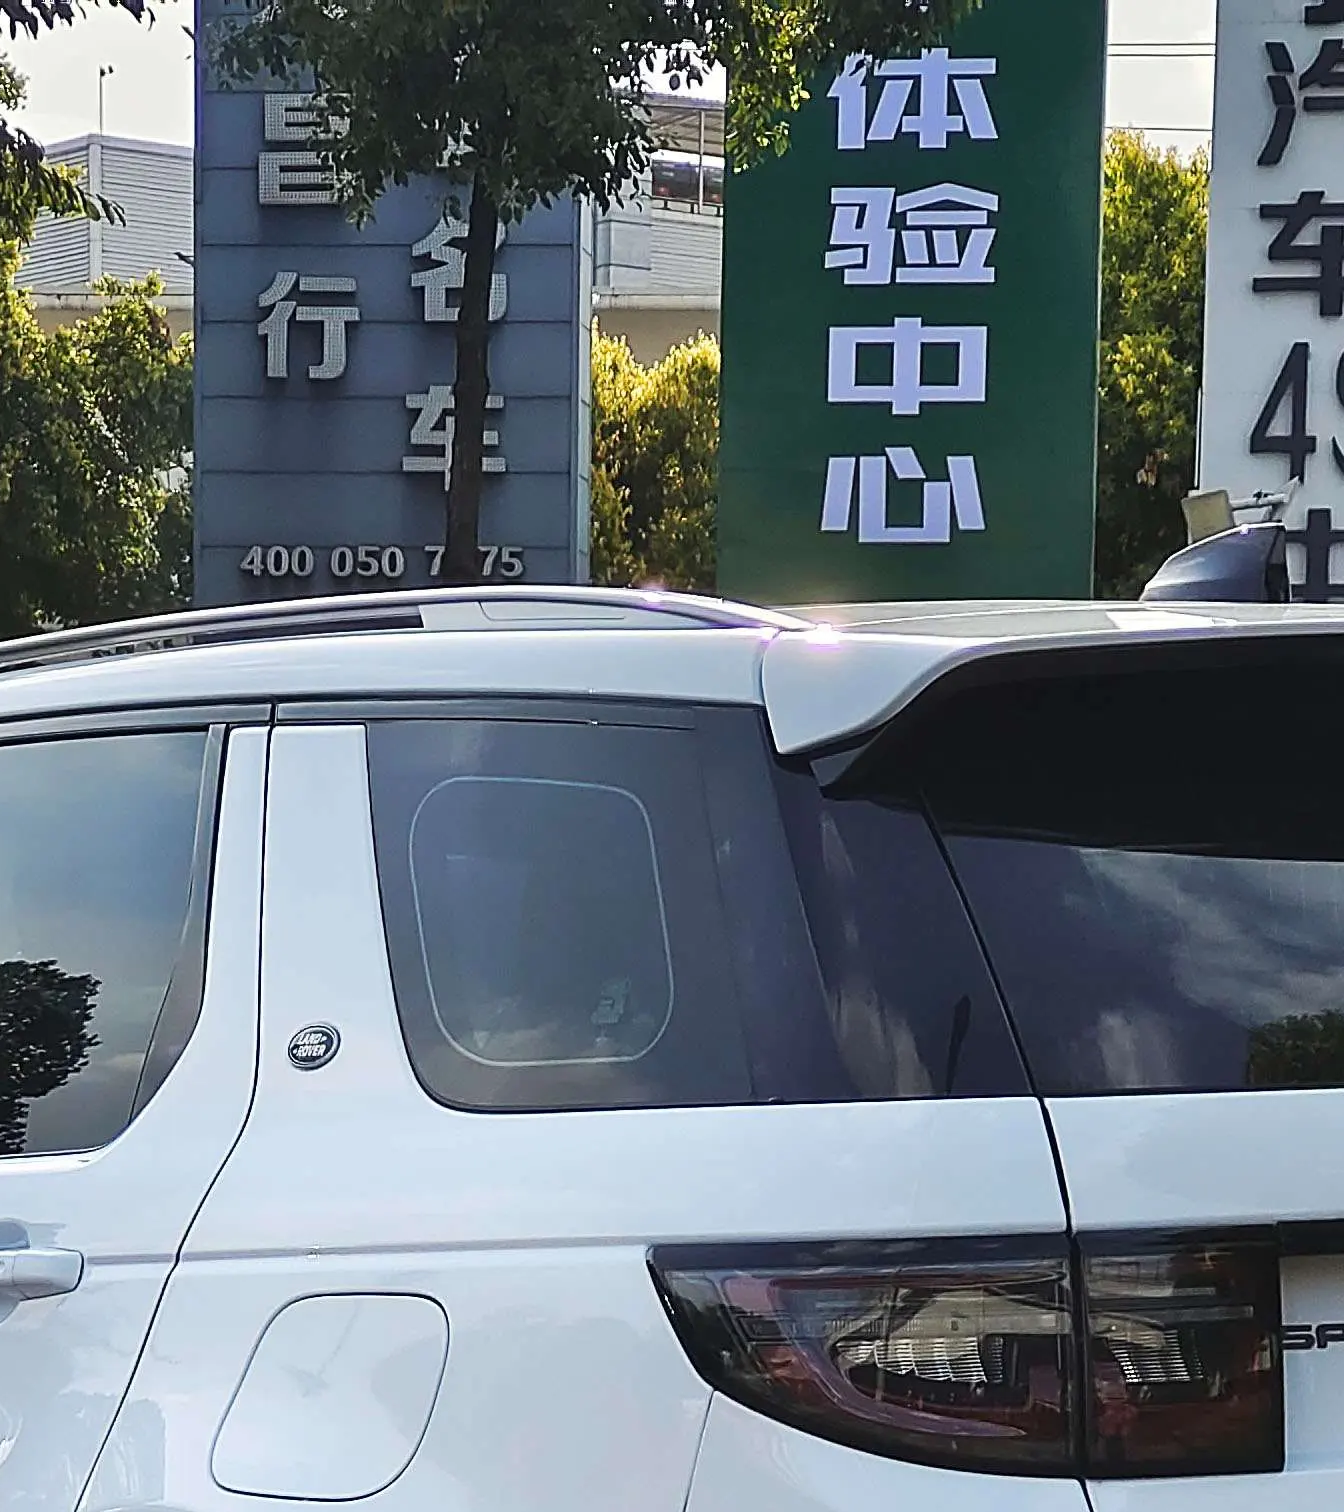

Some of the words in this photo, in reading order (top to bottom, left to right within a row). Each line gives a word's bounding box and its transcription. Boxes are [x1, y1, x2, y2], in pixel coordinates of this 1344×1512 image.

[820, 46, 998, 543] 体验中心
[239, 545, 315, 577] 400
[330, 545, 405, 577] 050
[423, 546, 525, 578] 775
